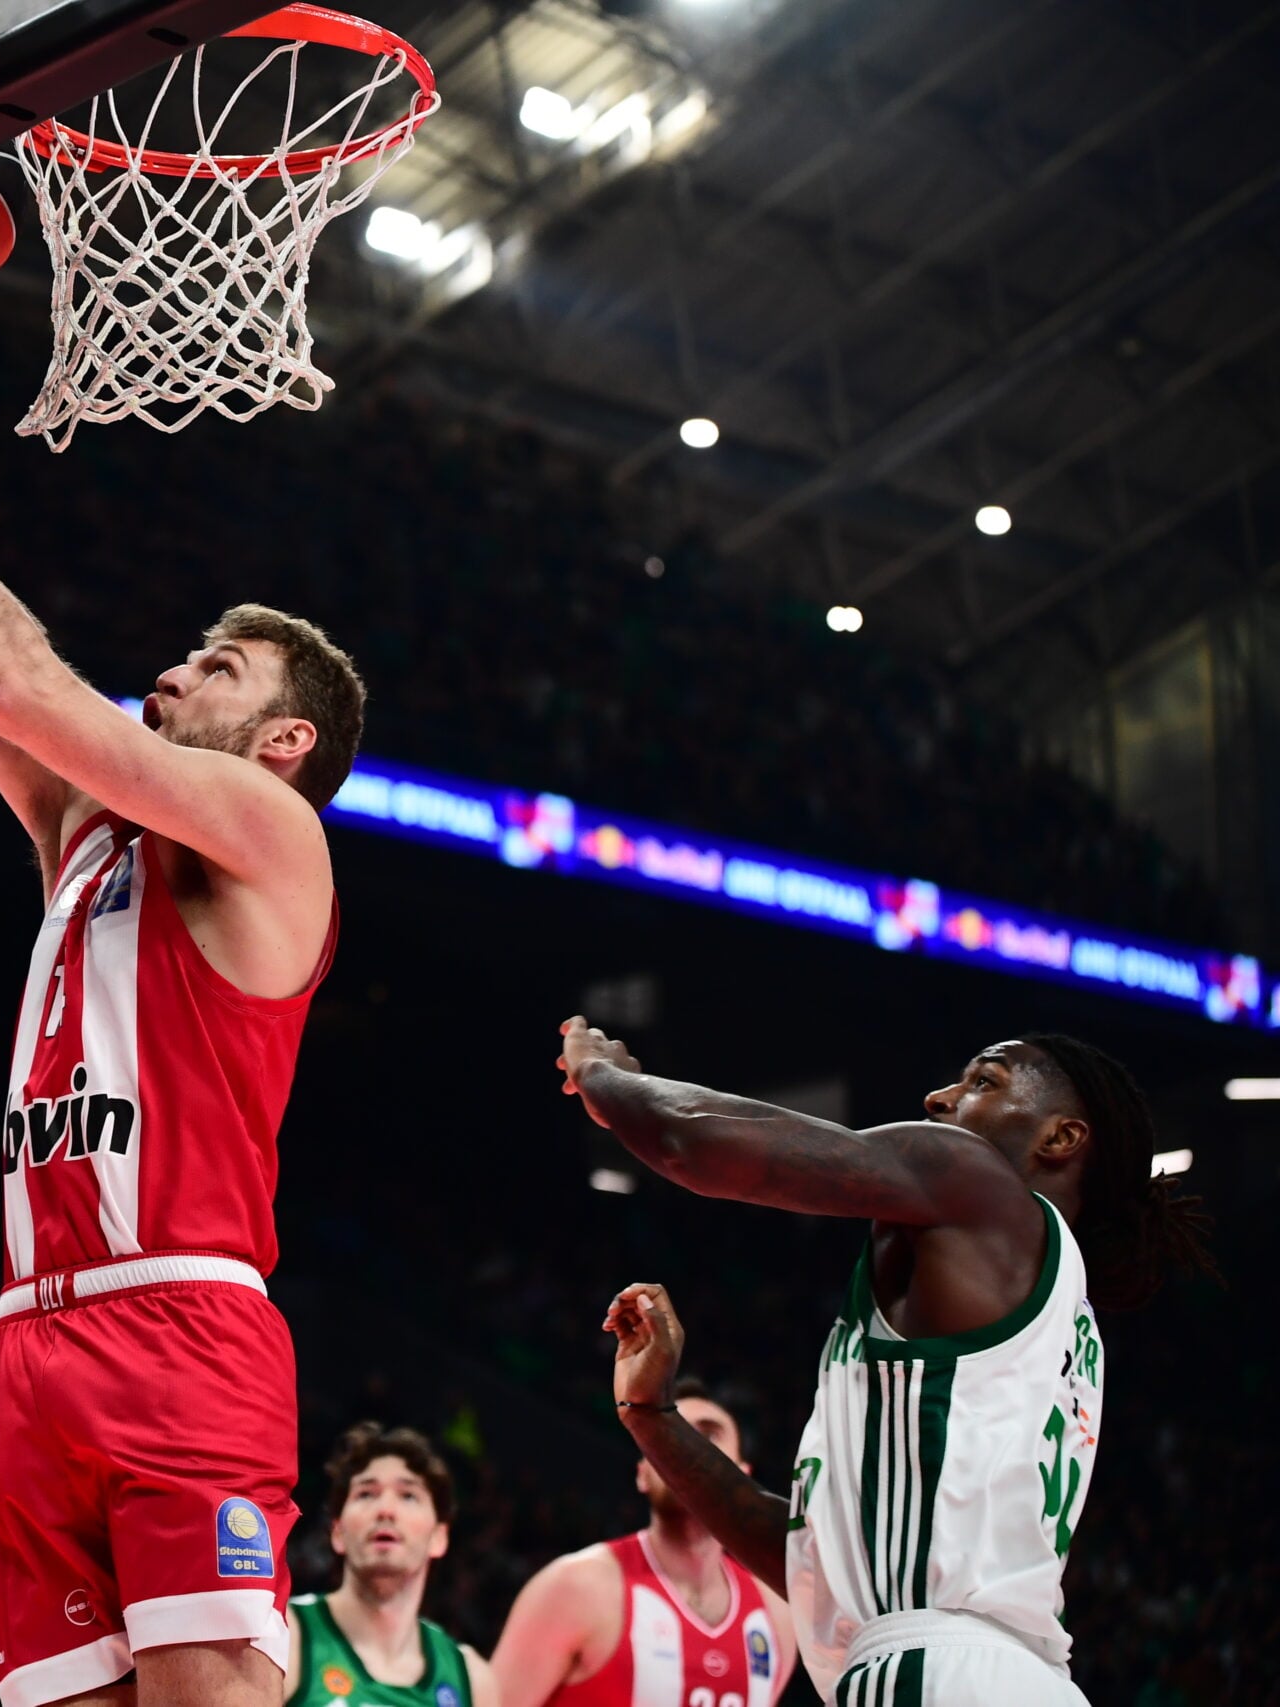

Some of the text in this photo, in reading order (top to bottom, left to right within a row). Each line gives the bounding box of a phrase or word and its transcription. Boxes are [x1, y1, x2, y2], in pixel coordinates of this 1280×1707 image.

[40, 1274, 65, 1310] OLY
[219, 1546, 270, 1558] Stoiximan
[233, 1560, 259, 1570] GBL
